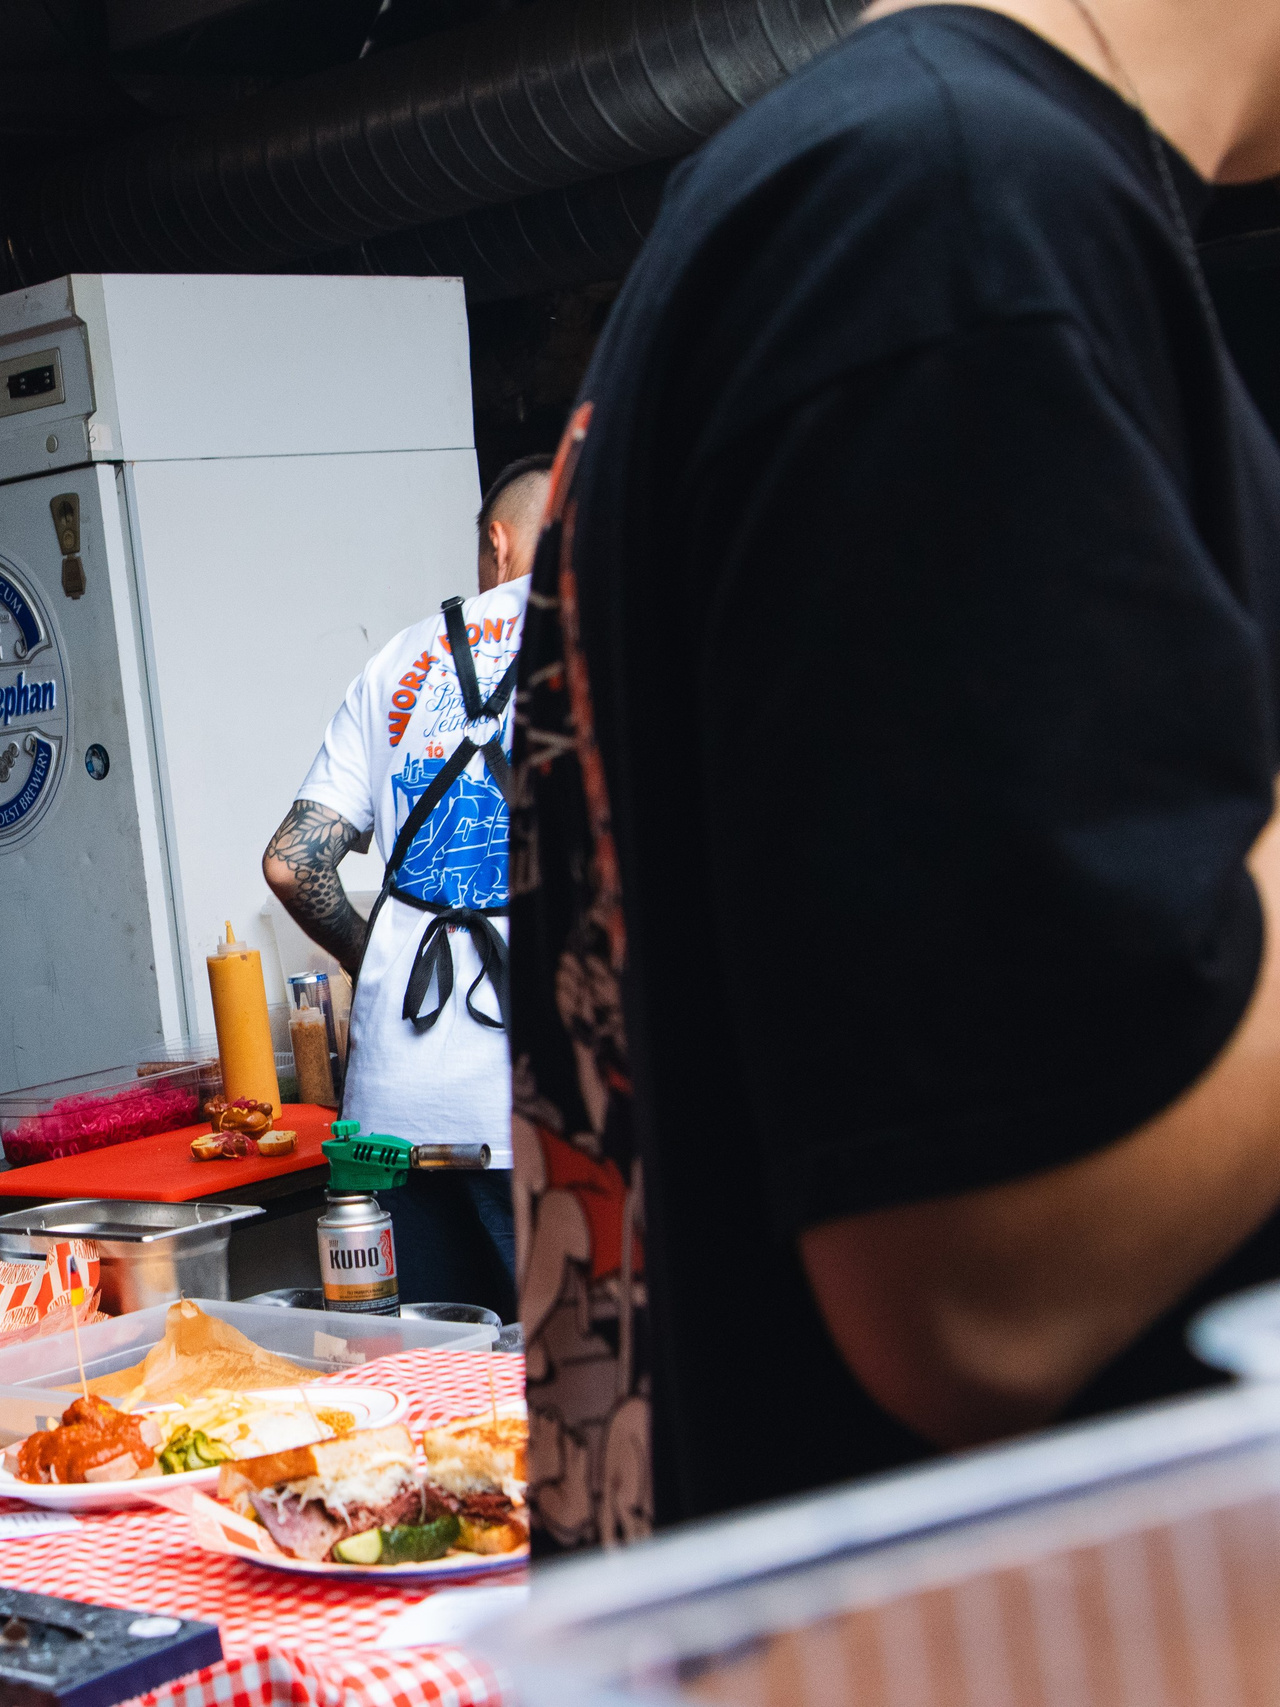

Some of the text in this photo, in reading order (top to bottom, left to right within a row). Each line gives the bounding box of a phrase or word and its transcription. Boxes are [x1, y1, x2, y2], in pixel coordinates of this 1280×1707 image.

[388, 651, 440, 747] WORK
[19, 747, 50, 812] BREWERY
[74, 1241, 99, 1260] FAMOU
[329, 1247, 380, 1270] KUDO
[16, 1267, 38, 1284] DOGS
